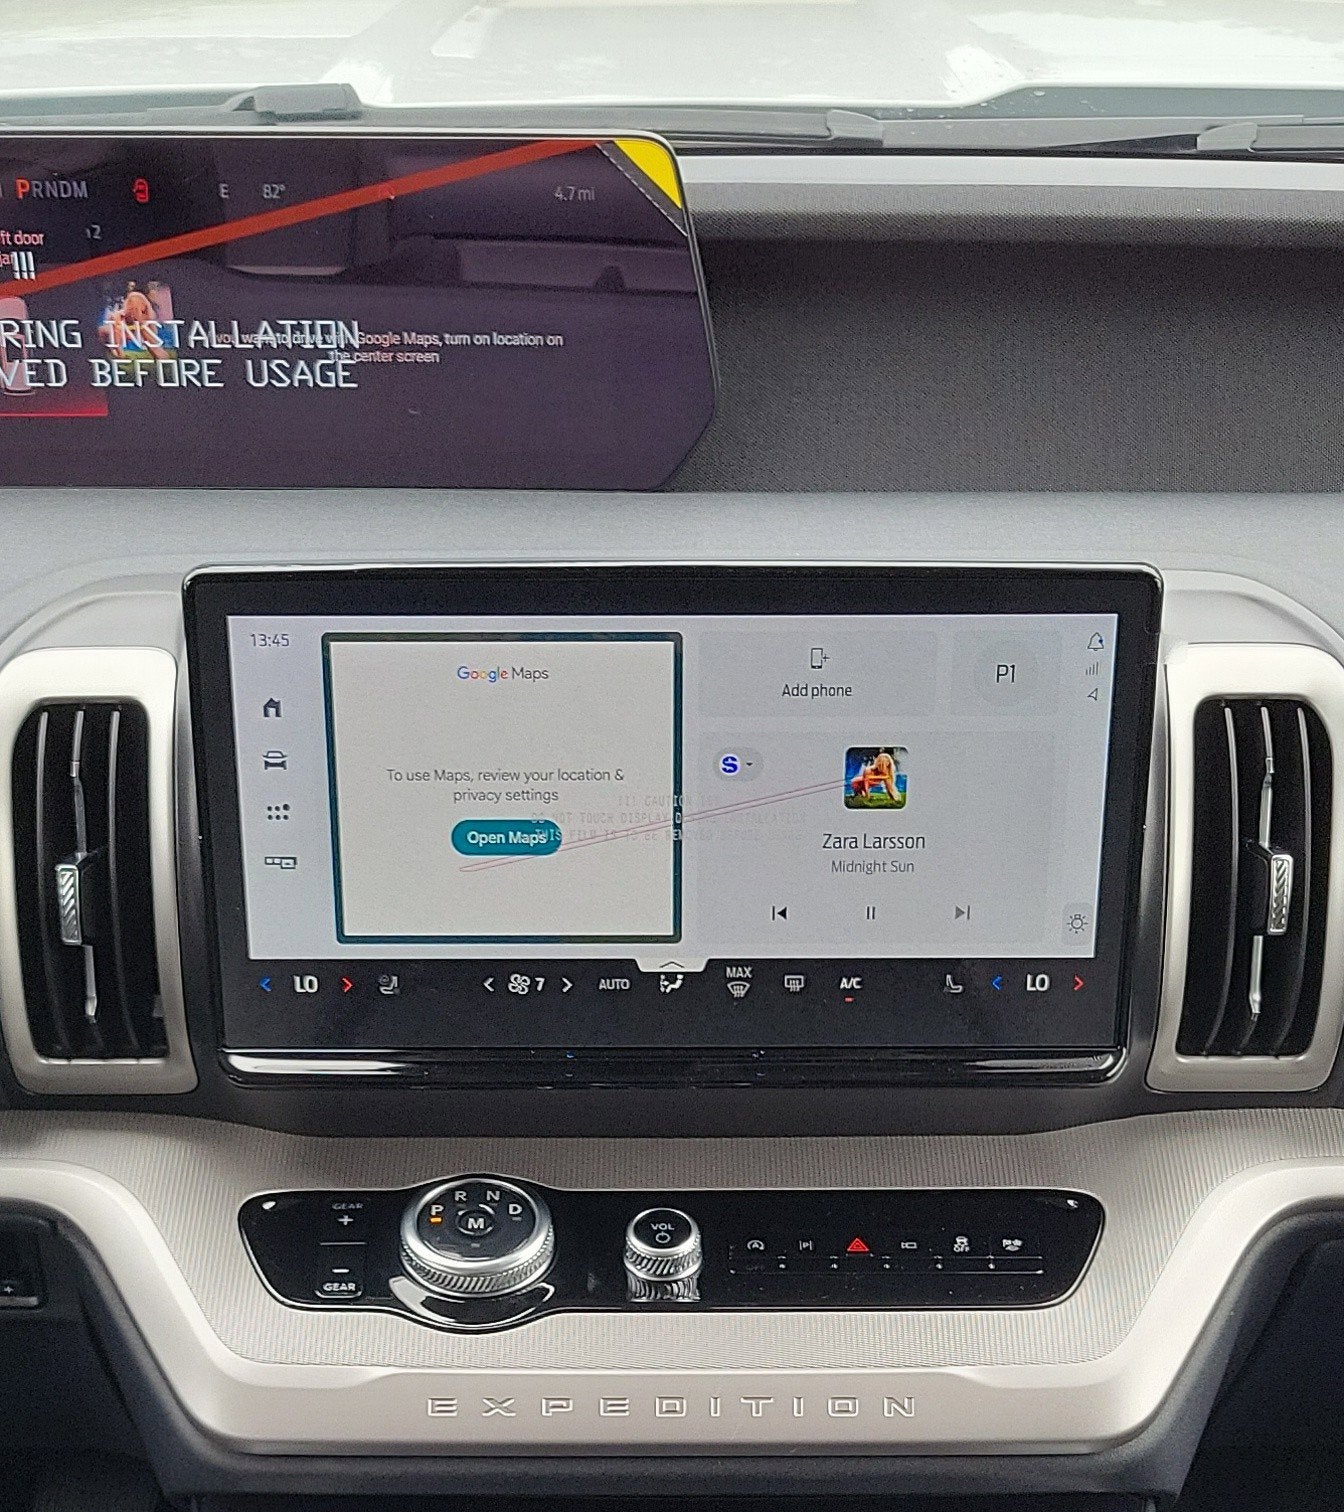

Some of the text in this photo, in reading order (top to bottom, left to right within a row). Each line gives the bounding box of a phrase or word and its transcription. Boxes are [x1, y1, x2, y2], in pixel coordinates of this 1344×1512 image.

[14, 230, 44, 246] door
[103, 319, 360, 349] INSTALLATION
[358, 331, 401, 348] Google
[403, 331, 443, 348] Maps,
[444, 333, 470, 346] turn
[473, 334, 490, 346] on
[492, 331, 544, 347] location
[546, 334, 564, 347] on
[355, 350, 394, 363] center
[397, 351, 440, 363] screen
[89, 359, 224, 387] BEFORE
[245, 359, 358, 388] USAGE
[250, 633, 290, 648] 13:45
[457, 665, 549, 684] Google Maps
[996, 664, 1017, 684] P1
[781, 683, 853, 699] Add phone
[386, 768, 625, 785] To use Maps, review your location &
[453, 788, 559, 805] privacy settings
[466, 830, 547, 848] Open Maps
[822, 833, 925, 849] Zara Larsson
[831, 860, 915, 875] Midnight Sun
[726, 966, 752, 979] MAX
[293, 975, 318, 993] LO
[534, 977, 546, 992] 7
[598, 978, 631, 991] AUTO
[840, 976, 863, 990] A/C
[1026, 974, 1050, 992] LO
[454, 1190, 467, 1201] R
[486, 1190, 500, 1201] N
[430, 1204, 444, 1216] P
[509, 1203, 523, 1215] D
[467, 1217, 485, 1229] M
[651, 1223, 675, 1231] VOL
[323, 1283, 356, 1292] GEAR
[427, 1396, 916, 1418] EXPEDITION
